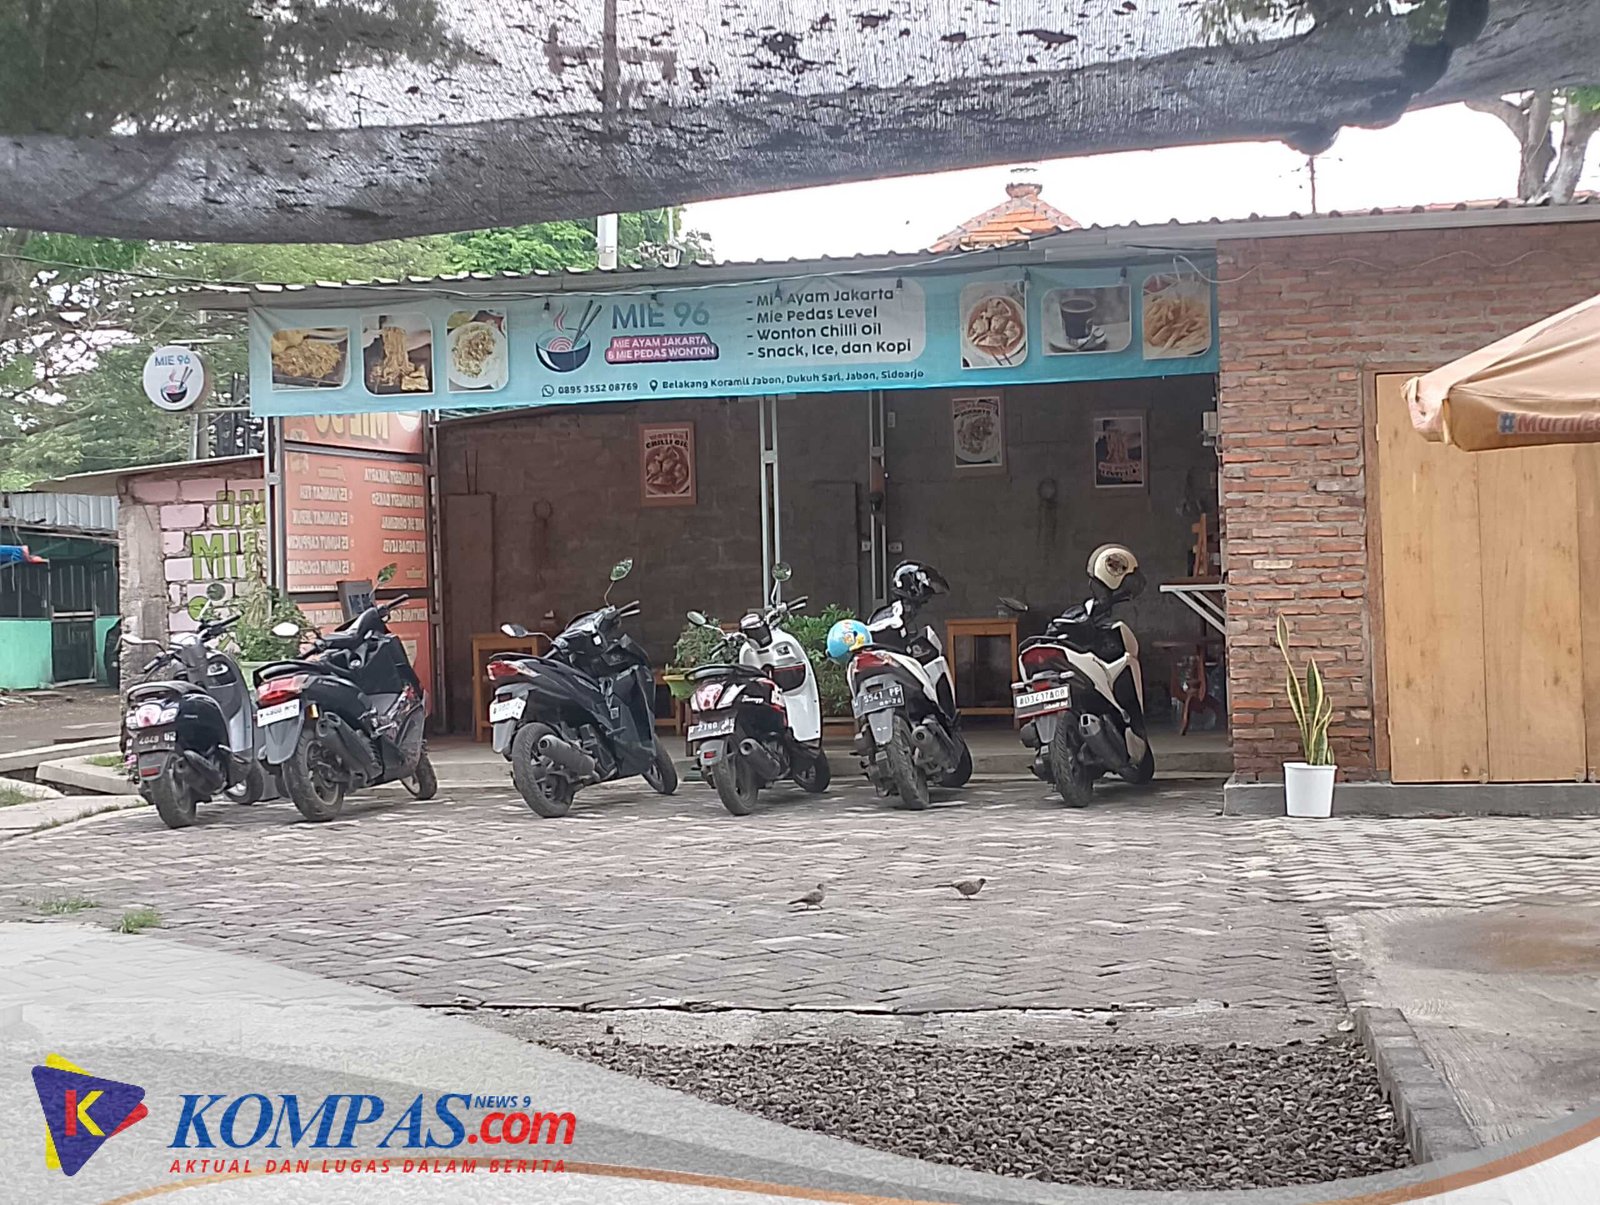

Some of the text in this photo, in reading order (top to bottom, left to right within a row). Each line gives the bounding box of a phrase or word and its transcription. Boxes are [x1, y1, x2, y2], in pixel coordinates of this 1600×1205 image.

[787, 290, 830, 306] Ayam
[834, 287, 894, 302] Jakarta
[611, 301, 710, 330] MIE 96
[756, 305, 878, 324] Mie Pedas Level
[756, 322, 881, 341] Wonton Chilli Oil
[613, 335, 708, 349] MIE AYAM JAKARTA
[757, 338, 911, 358] Snack, Ice, dan Kopi
[154, 354, 191, 367] MIE 96
[616, 349, 633, 359] MIE
[634, 348, 666, 359] PEDAS
[668, 346, 715, 357] WONTON
[662, 379, 709, 390] Belakang
[710, 376, 750, 388] Koramil
[786, 373, 820, 384] Dukuh
[845, 370, 879, 382] Jabon,
[881, 368, 925, 381] Sidoarjo
[558, 385, 582, 394] 0895
